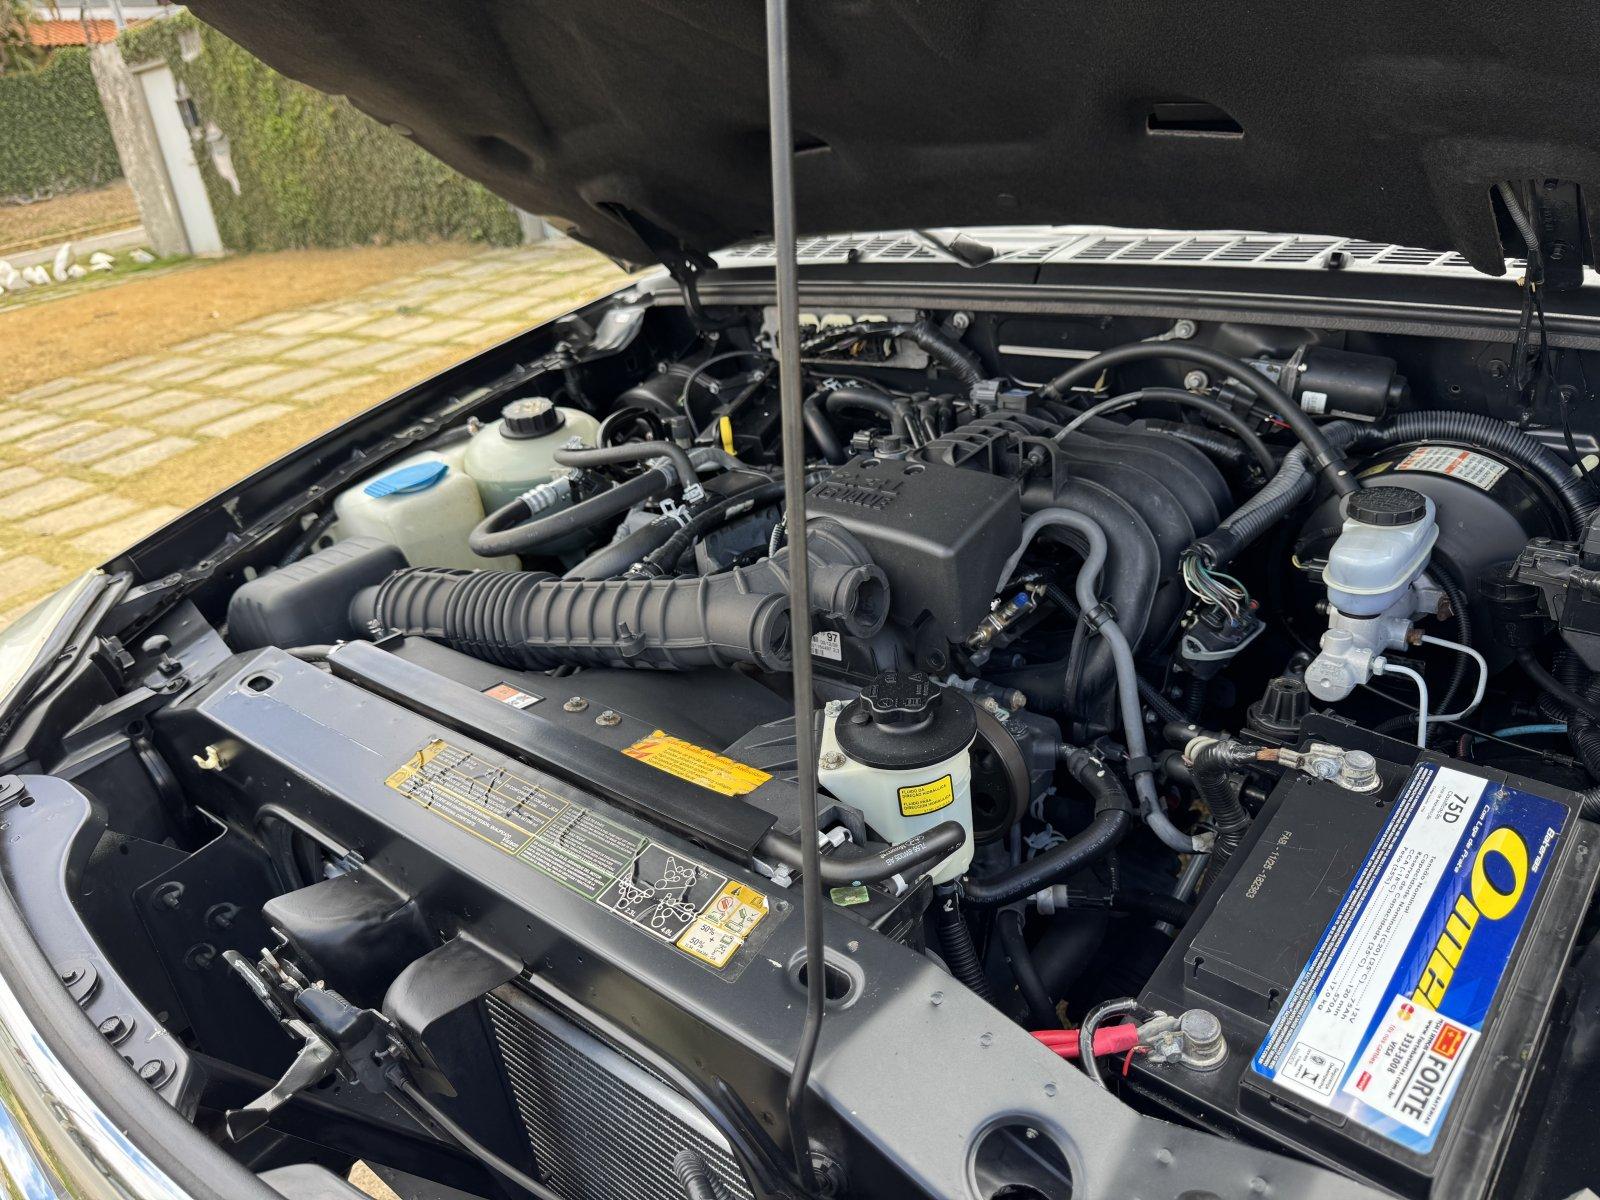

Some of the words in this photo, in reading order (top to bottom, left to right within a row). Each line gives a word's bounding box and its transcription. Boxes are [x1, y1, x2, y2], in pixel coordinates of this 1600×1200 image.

[827, 633, 837, 642] 97
[1440, 792, 1469, 825] 75D
[1478, 804, 1490, 820] Com
[1469, 820, 1482, 837] Liga
[1464, 838, 1474, 849] de
[1529, 826, 1556, 873] Baterias
[1395, 846, 1408, 862] Peso
[1402, 848, 1415, 865] CCA
[1453, 849, 1469, 873] Prata
[1403, 850, 1421, 879] Reserva
[1420, 855, 1436, 880] Tensão
[1397, 880, 1406, 891] de
[1400, 852, 1429, 900] Capacidade
[1371, 891, 1400, 940] Capacidade
[1384, 901, 1404, 933] Nominal
[1411, 825, 1530, 1013] Ome
[700, 924, 715, 936] 50%
[689, 936, 706, 948] 50%
[1332, 1000, 1345, 1016] min
[1384, 1040, 1397, 1056] VISA
[1386, 1032, 1414, 1073] 3333-3008
[1399, 1054, 1448, 1120] FORTE
